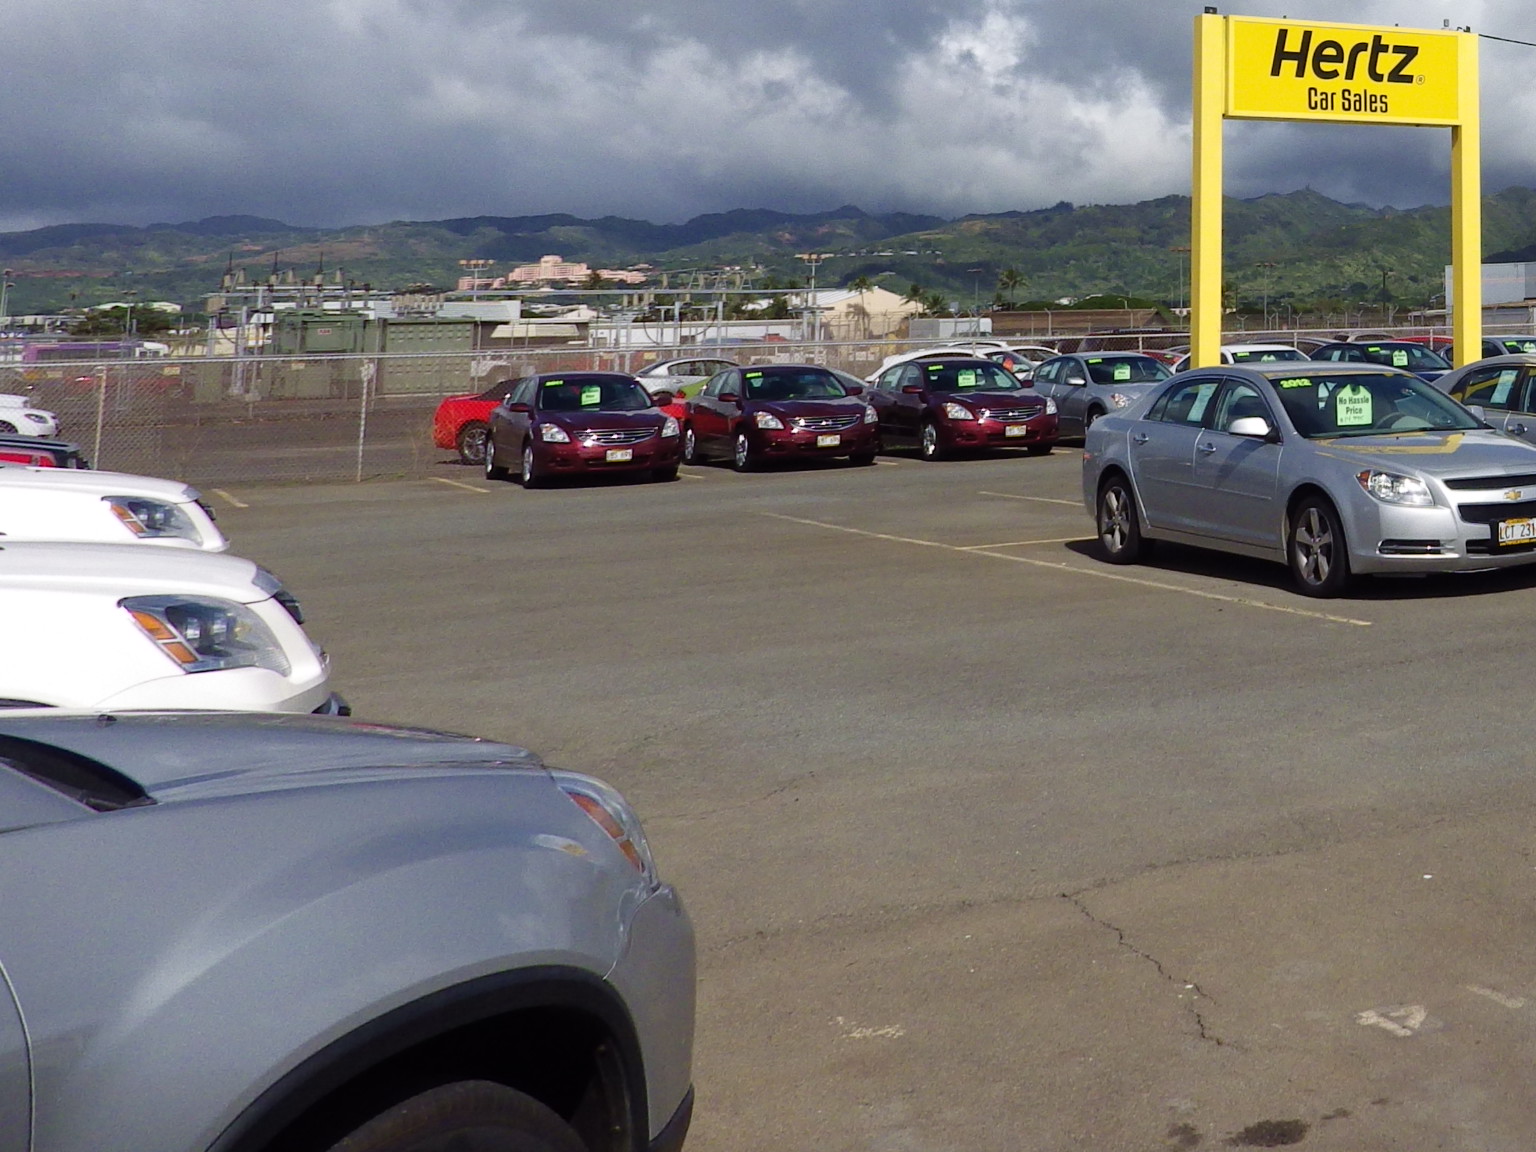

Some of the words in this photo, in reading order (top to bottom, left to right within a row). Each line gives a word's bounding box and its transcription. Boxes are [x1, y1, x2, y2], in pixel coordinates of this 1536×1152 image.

[1270, 28, 1419, 84] Hertz
[1307, 87, 1336, 111] Car
[1341, 88, 1389, 114] Sales
[1280, 378, 1312, 389] 2012
[1338, 396, 1347, 405] No
[1348, 395, 1370, 405] Hassle
[1345, 406, 1363, 415] Price
[1500, 524, 1515, 539] LCT
[1520, 523, 1535, 538] 231
